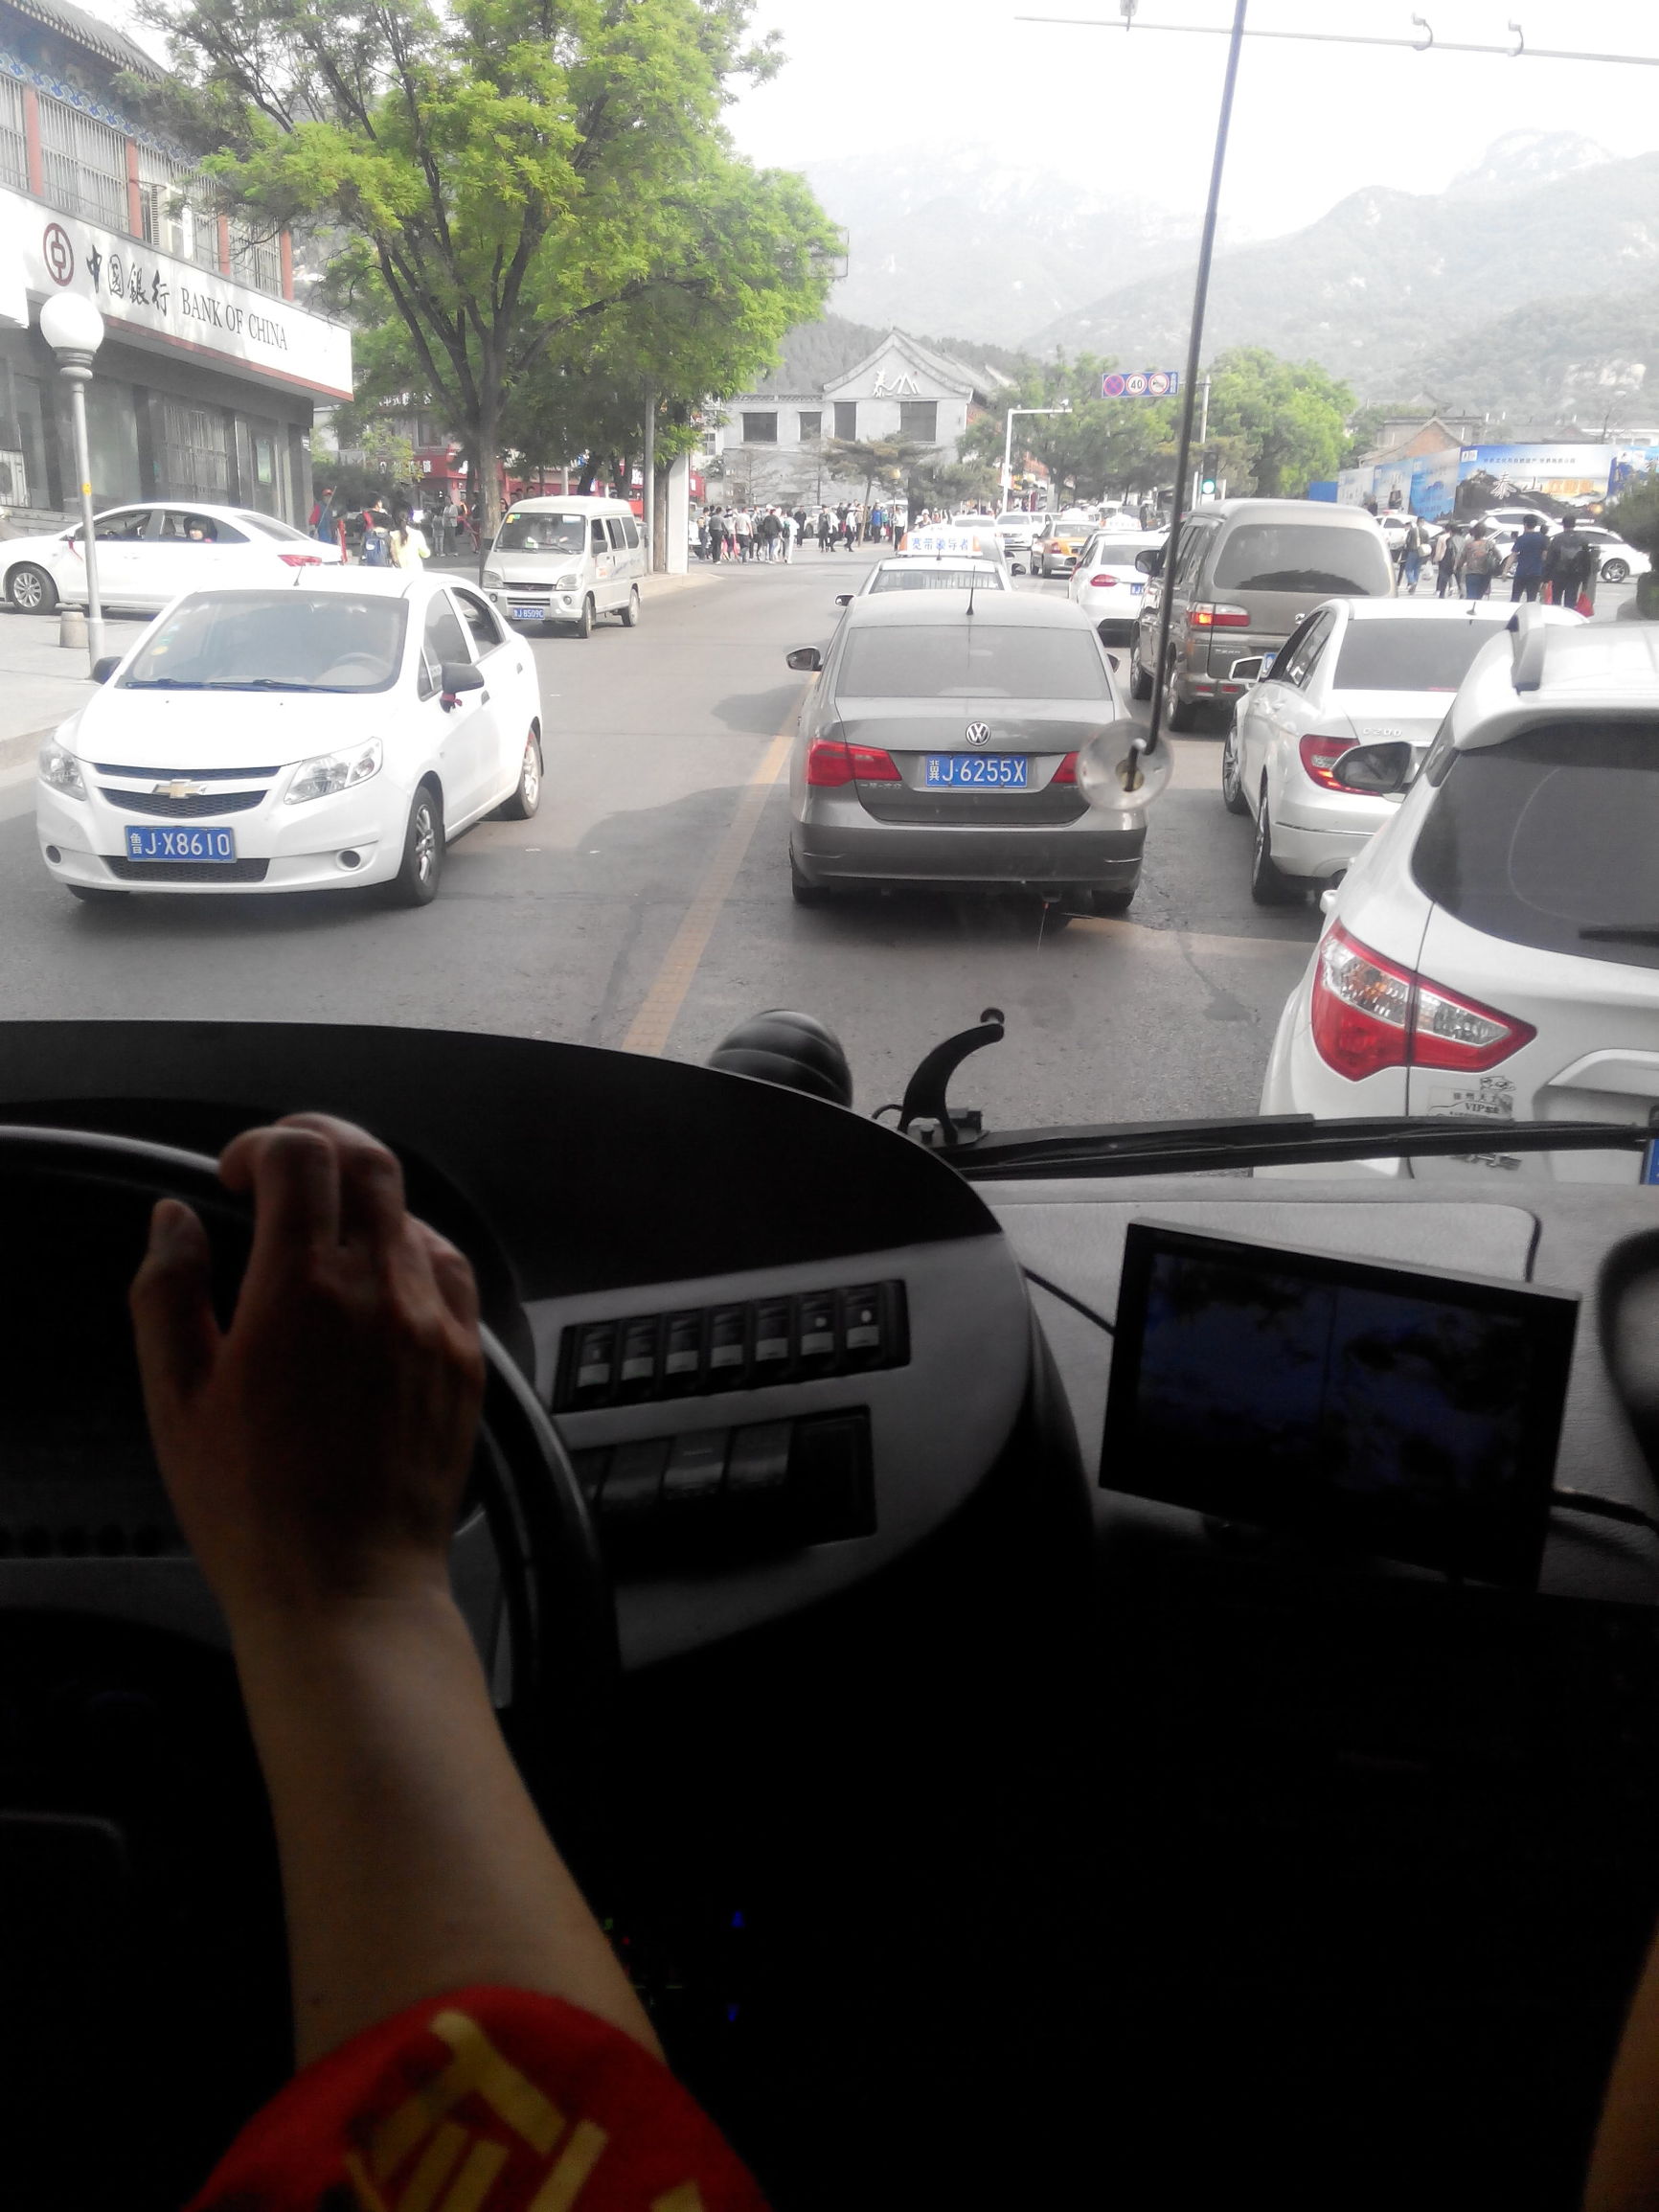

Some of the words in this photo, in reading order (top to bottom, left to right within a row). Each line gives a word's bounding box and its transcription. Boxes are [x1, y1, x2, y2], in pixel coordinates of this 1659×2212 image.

[181, 286, 222, 328] BANK
[226, 305, 243, 334] OF
[249, 313, 287, 351] CHINA
[1130, 379, 1143, 390] 40
[1489, 471, 1543, 500] 泰山
